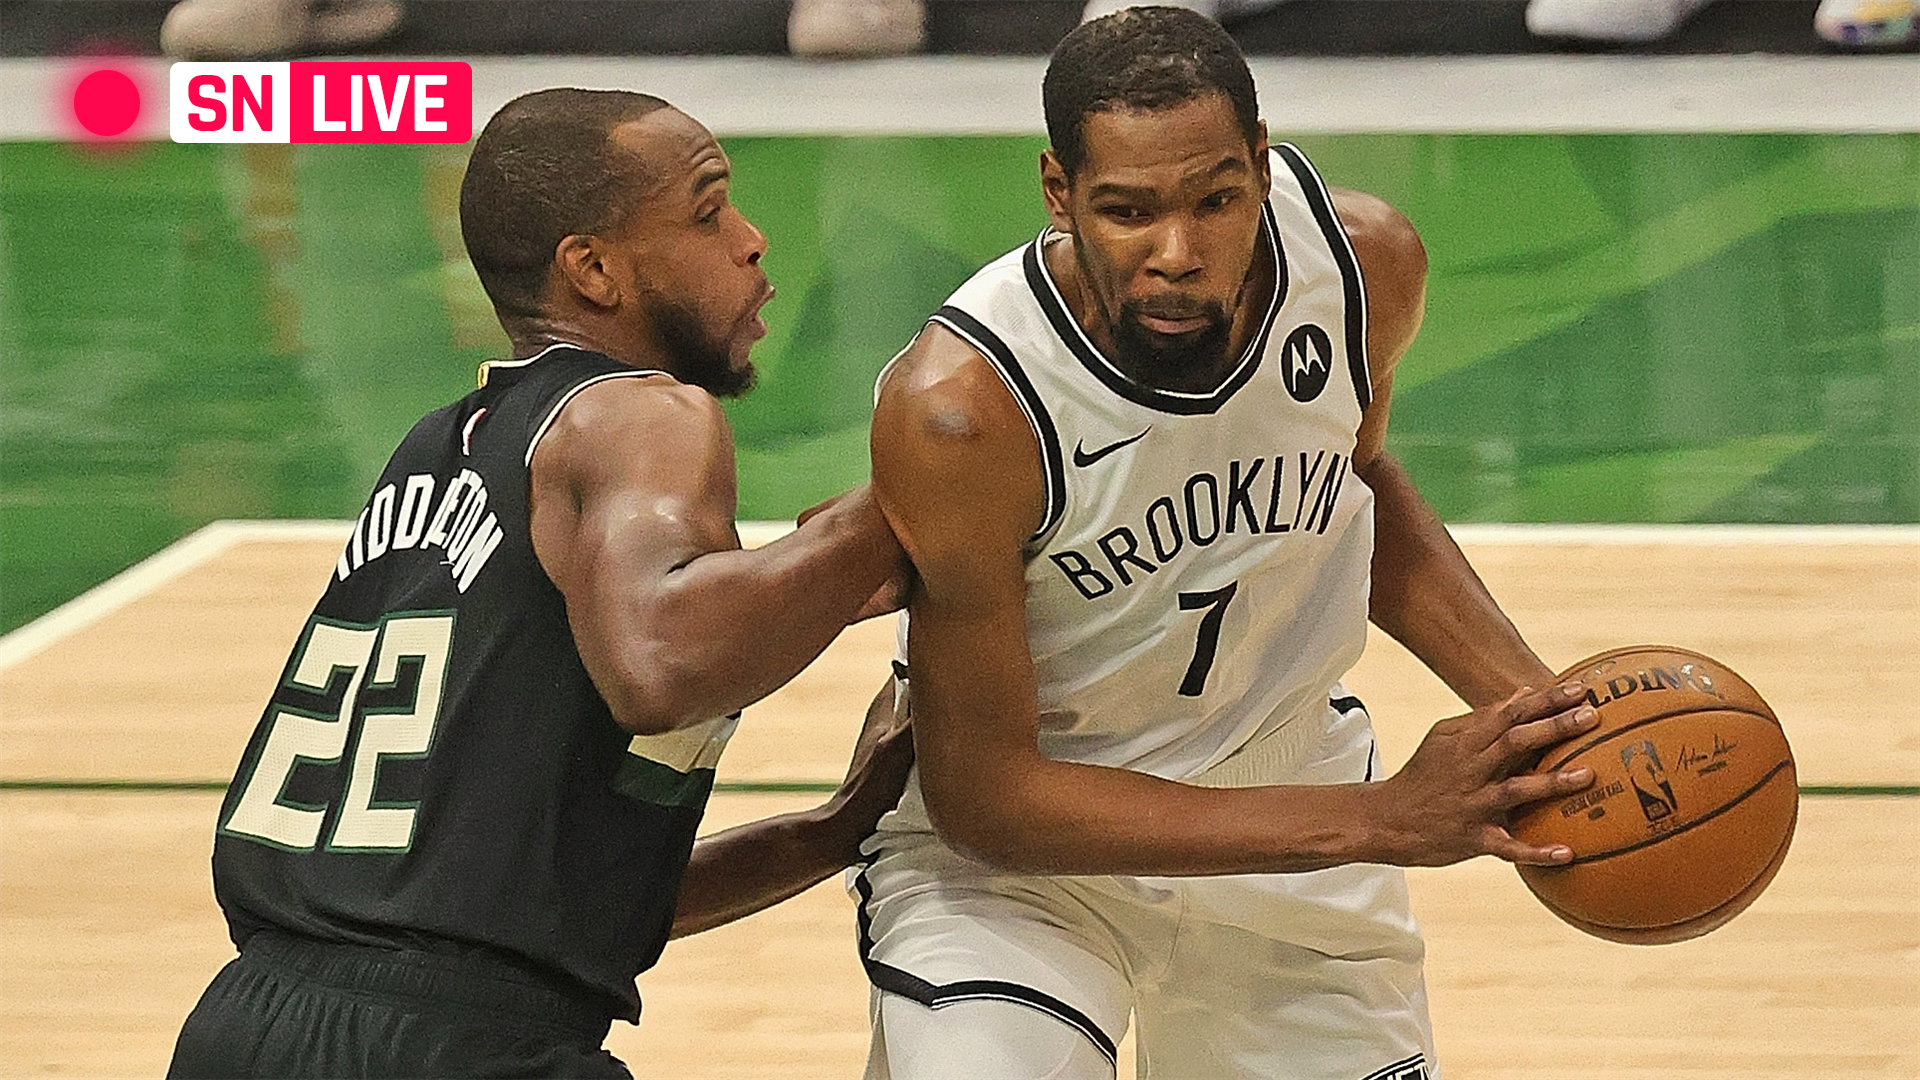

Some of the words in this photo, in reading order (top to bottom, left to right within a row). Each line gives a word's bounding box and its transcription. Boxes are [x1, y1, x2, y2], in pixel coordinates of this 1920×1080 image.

[1048, 450, 1349, 600] BROOKLYN
[1177, 580, 1239, 697] 7
[1585, 662, 1717, 709] LDING
[220, 610, 456, 852] 22
